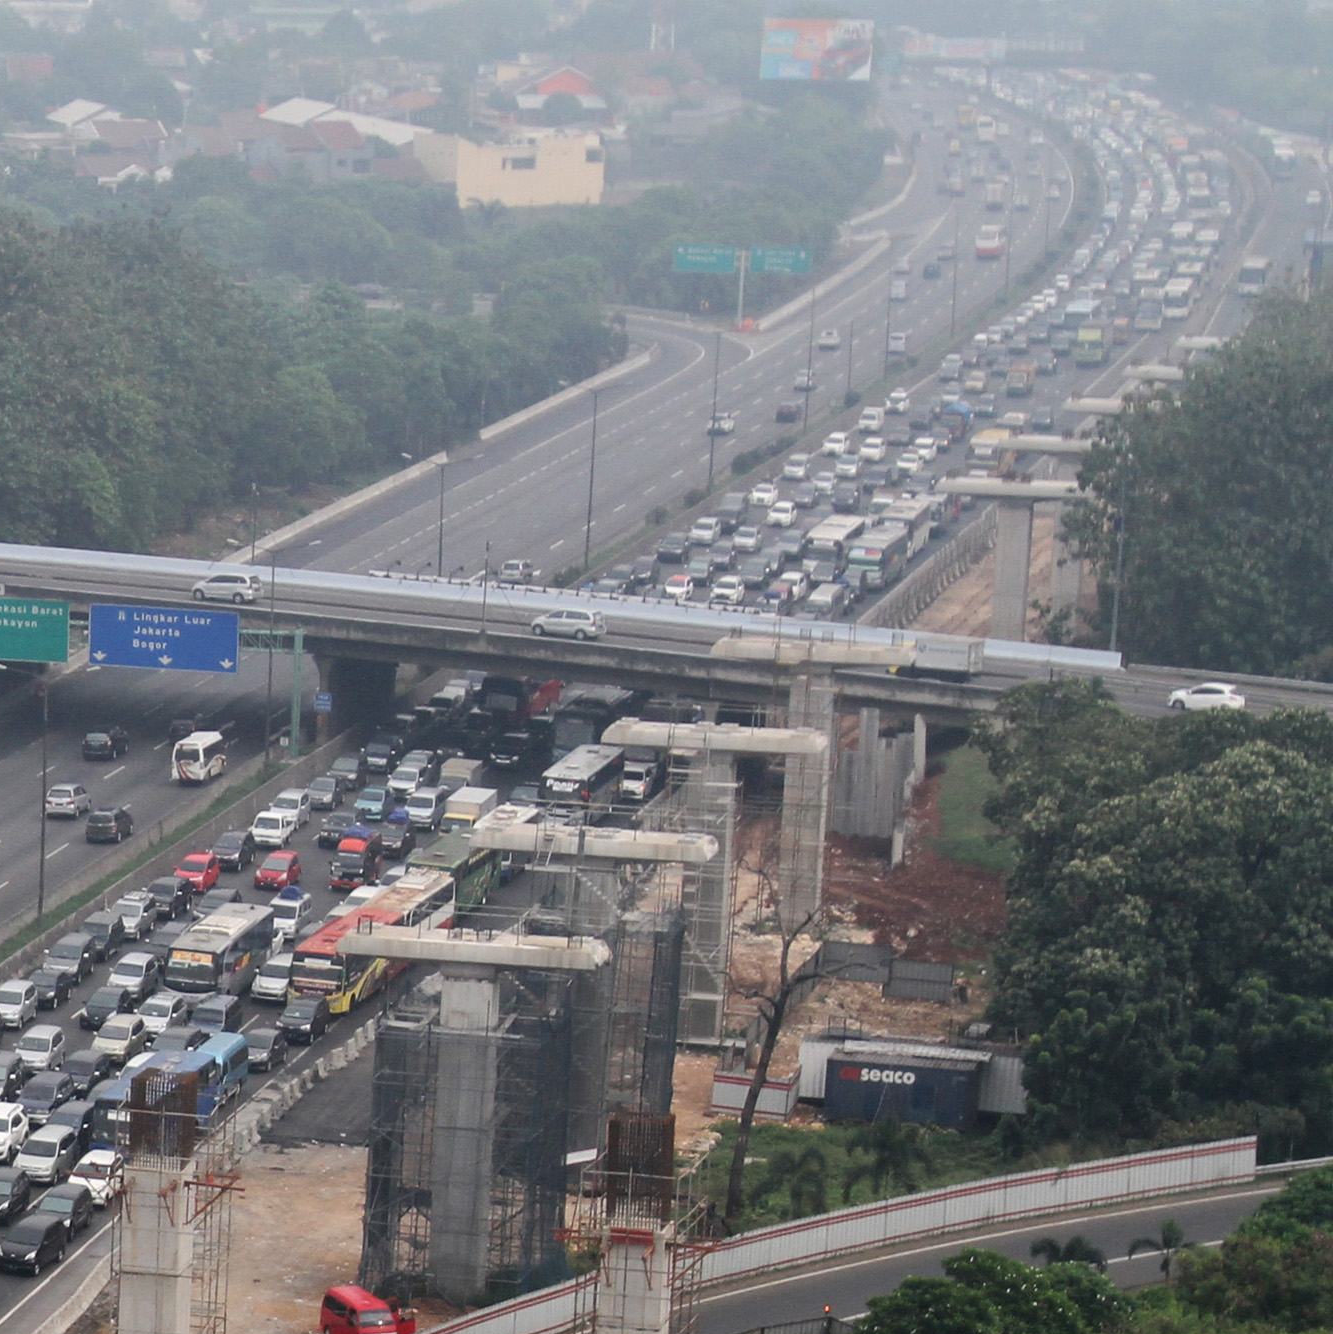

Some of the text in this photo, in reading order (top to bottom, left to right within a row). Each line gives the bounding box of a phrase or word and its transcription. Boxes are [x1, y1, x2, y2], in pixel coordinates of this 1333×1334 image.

[32, 605, 64, 616] Barat
[133, 612, 212, 625] Lingkar Luar
[134, 626, 180, 638] Jakarta
[133, 638, 167, 651] Bogor
[860, 1068, 916, 1084] seaco
